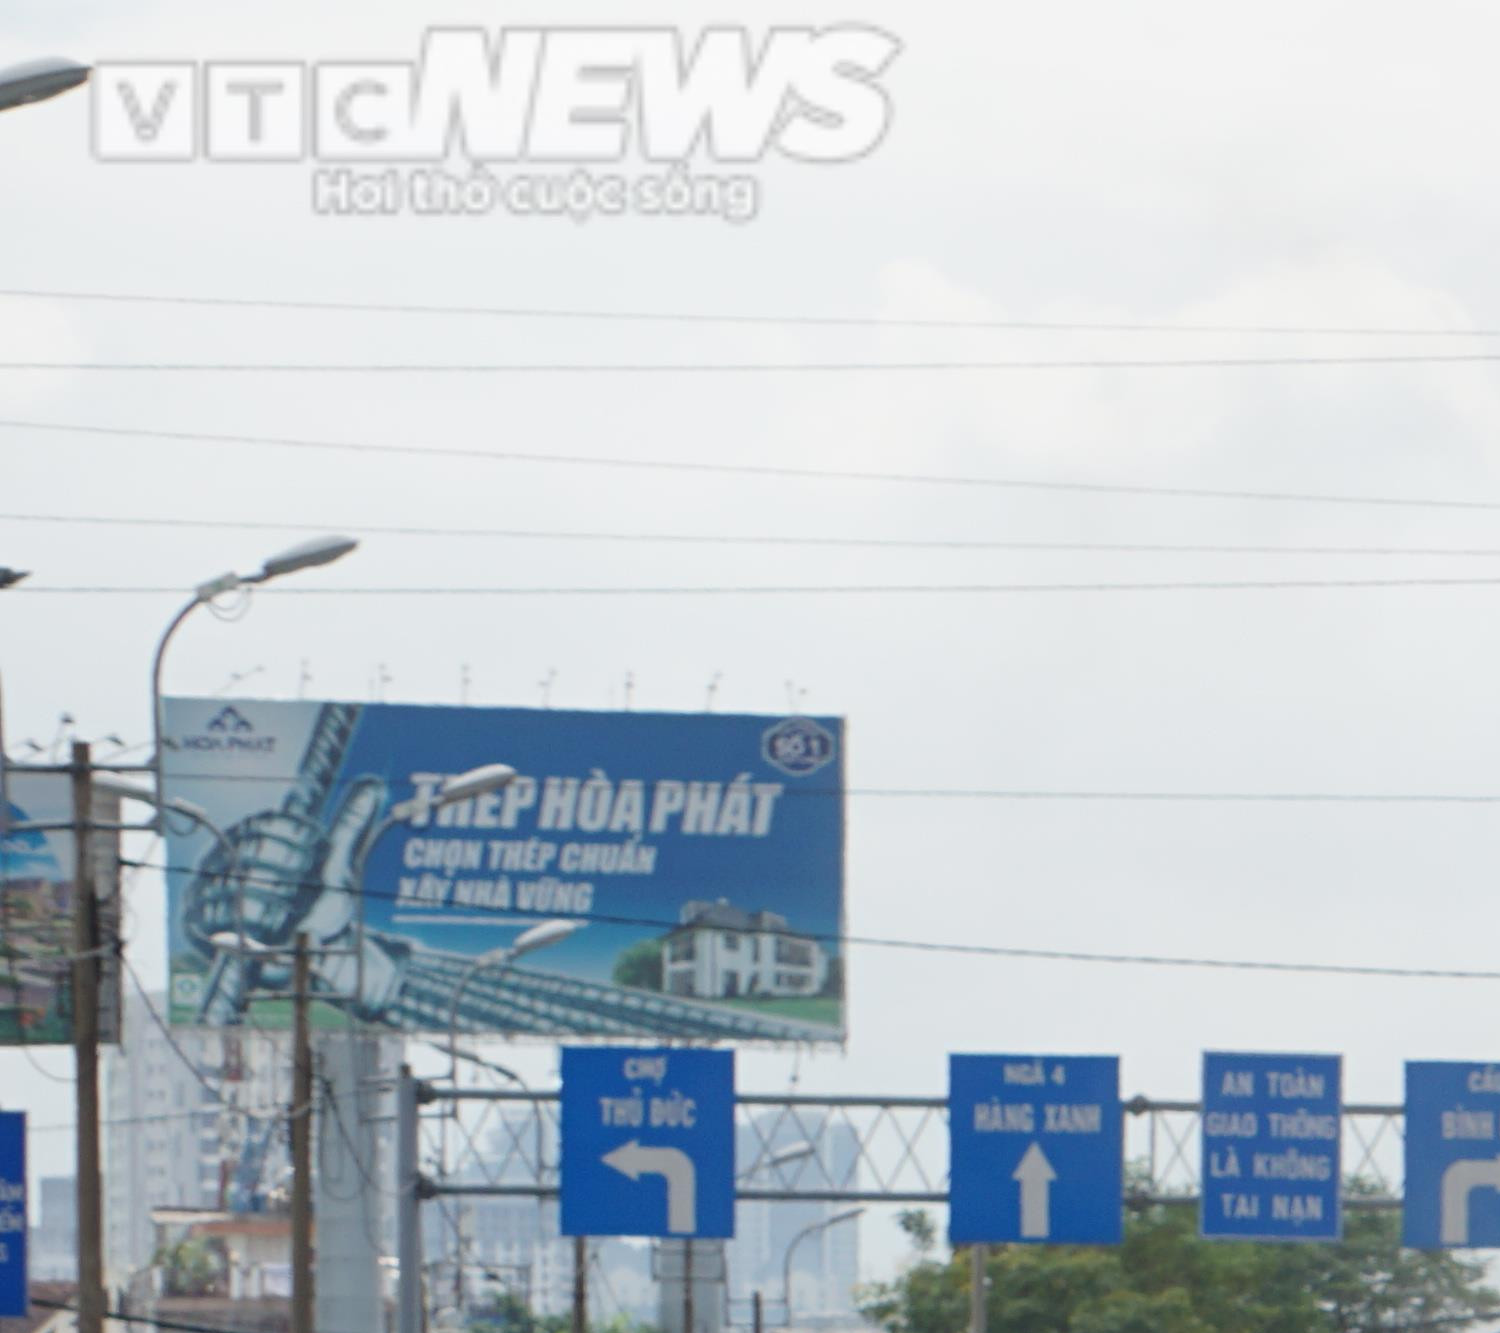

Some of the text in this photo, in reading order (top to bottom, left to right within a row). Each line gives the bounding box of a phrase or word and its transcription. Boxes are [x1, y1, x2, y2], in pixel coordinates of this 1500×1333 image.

[537, 767, 646, 832] HÒA
[648, 771, 785, 837] PHÁT
[403, 832, 659, 877] CHỌN THÉP CHUẨN
[515, 876, 595, 915] VỮNG
[1050, 1065, 1066, 1086] 4
[1222, 1064, 1325, 1099] AN TOÀN
[600, 1087, 697, 1129] THỦ ĐỨC
[973, 1095, 1103, 1134] HÀNG XANH
[1205, 1108, 1337, 1140] GIAO THÔNG
[1441, 1104, 1494, 1140] BÌNH
[1209, 1145, 1331, 1181] LÀ KHÔNG
[1222, 1193, 1324, 1228] TAI NẠN
